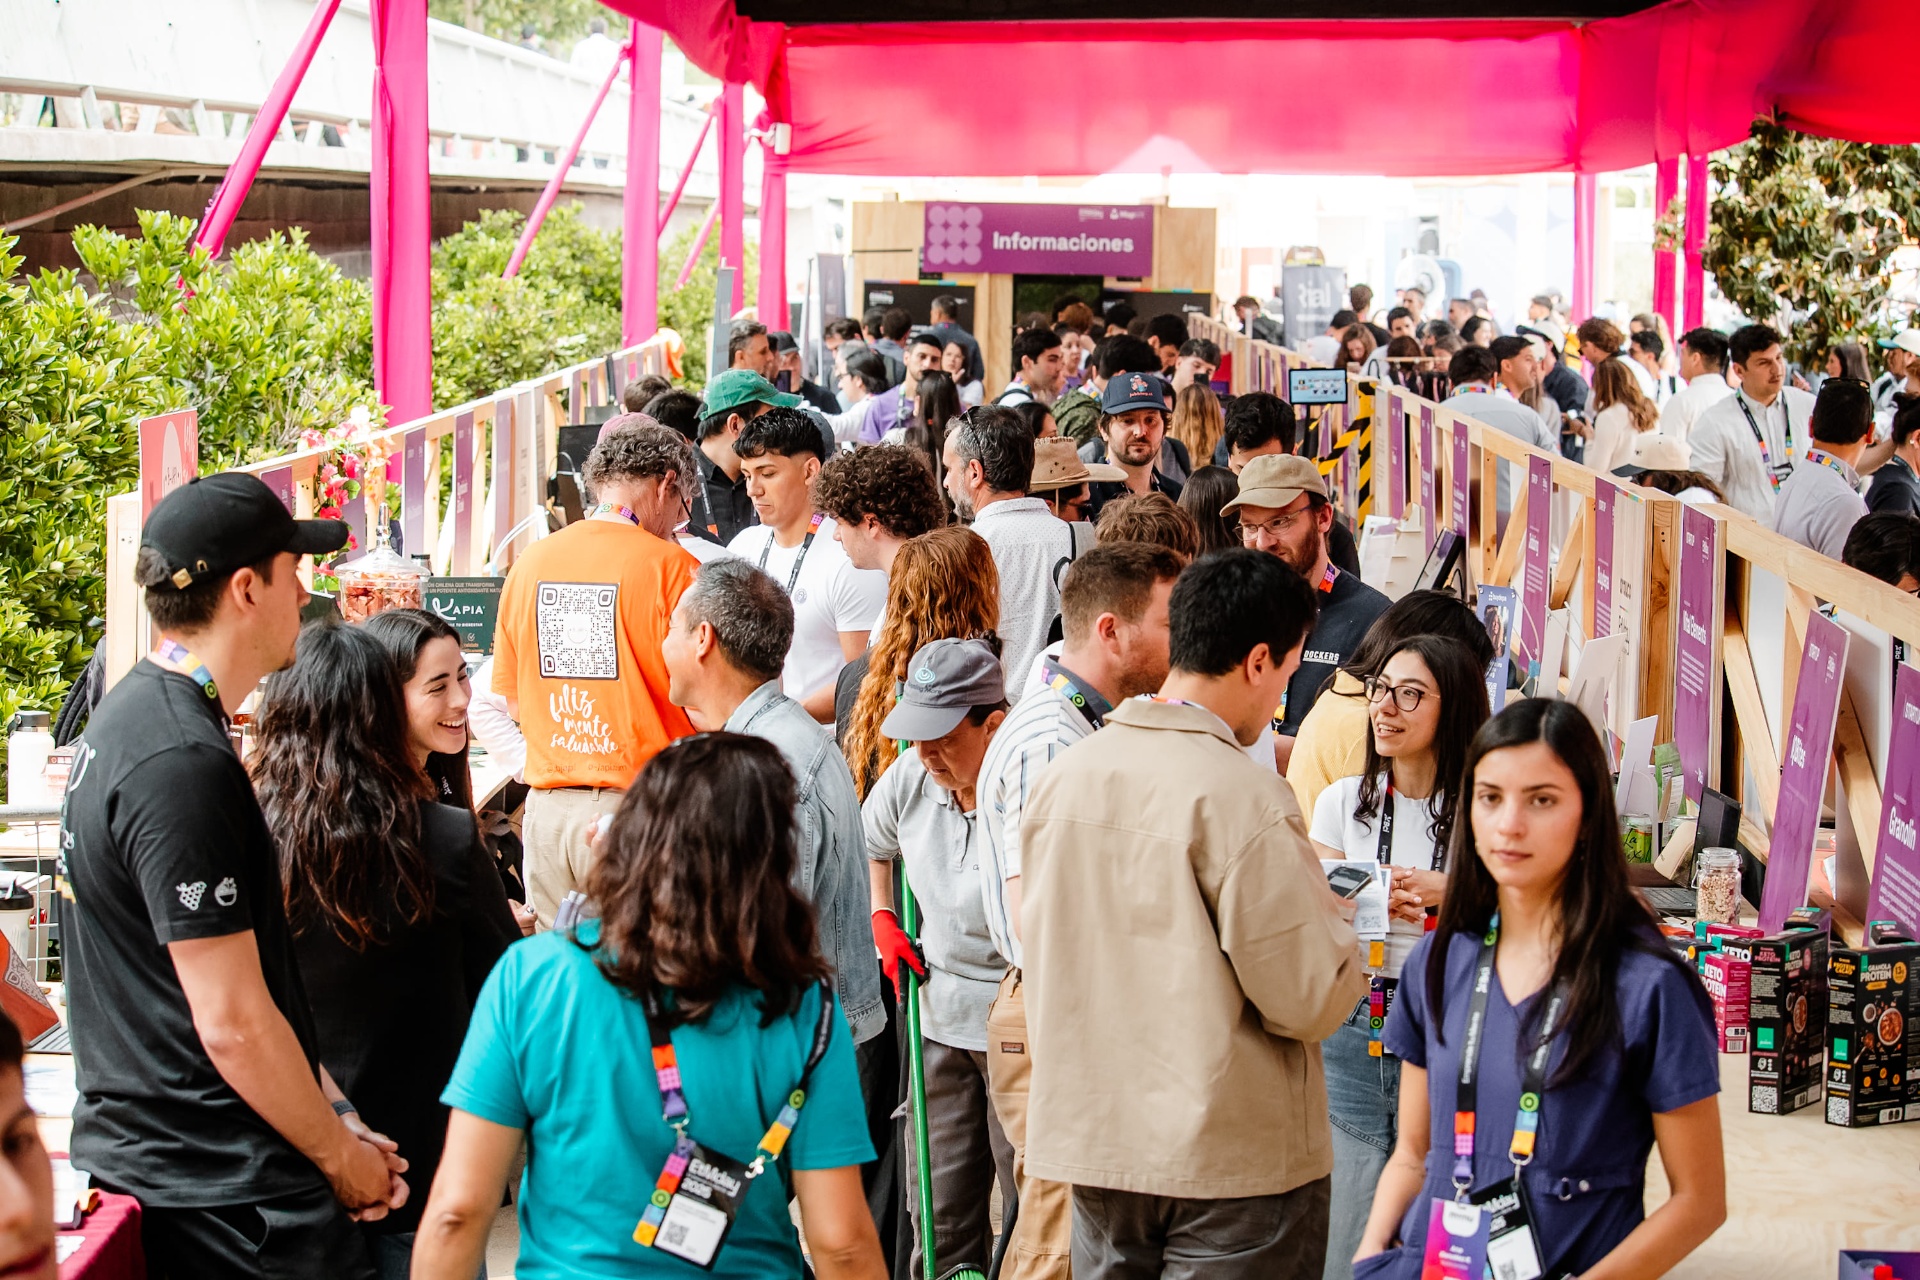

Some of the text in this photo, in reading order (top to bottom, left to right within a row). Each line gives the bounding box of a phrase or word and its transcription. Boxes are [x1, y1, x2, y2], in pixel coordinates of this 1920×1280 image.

[993, 231, 1134, 252] Informaciones
[1304, 650, 1340, 660] DOCKERS
[549, 683, 597, 722] feliz
[564, 714, 612, 738] mente
[550, 733, 618, 755] saludable
[1888, 806, 1916, 851] Granolin
[1704, 962, 1723, 982] KETO
[1860, 970, 1892, 982] PROTEIN
[1868, 963, 1892, 972] GRANOLA
